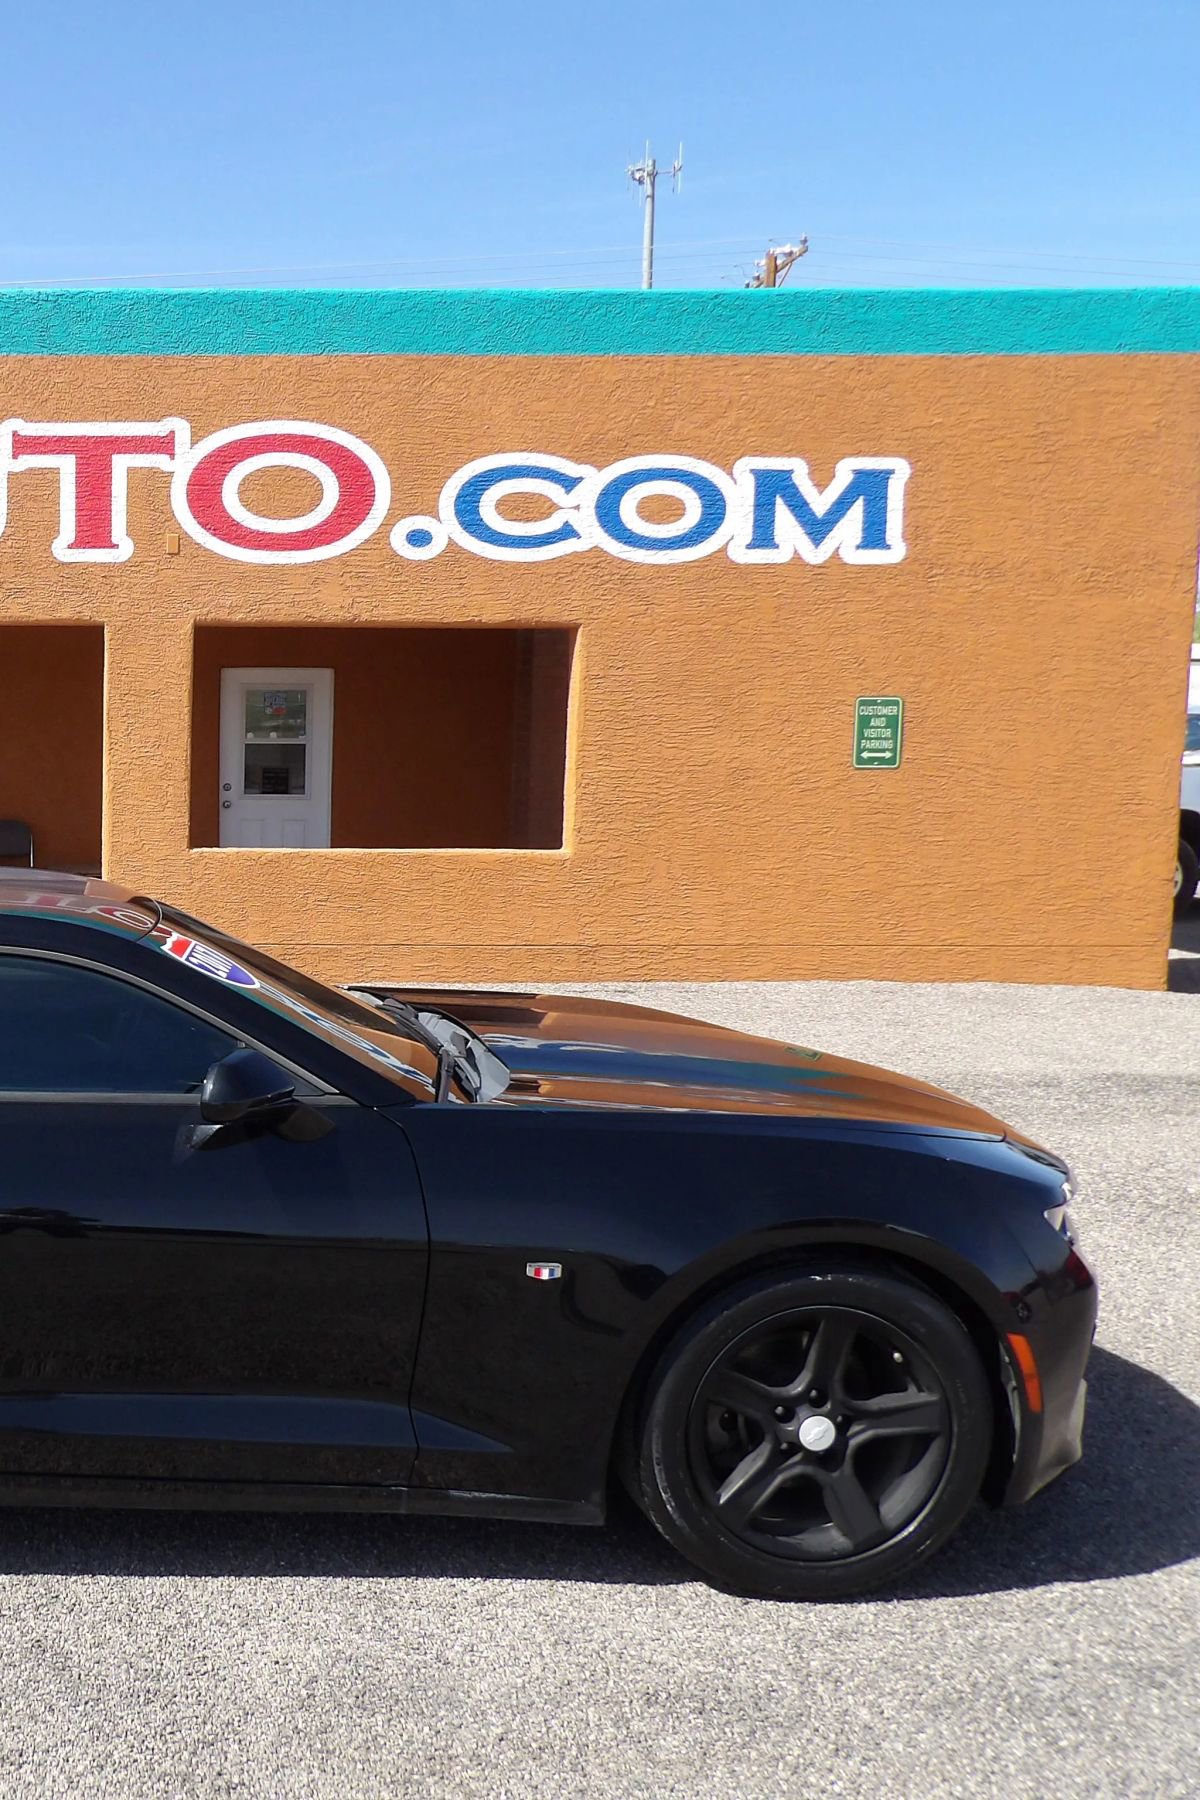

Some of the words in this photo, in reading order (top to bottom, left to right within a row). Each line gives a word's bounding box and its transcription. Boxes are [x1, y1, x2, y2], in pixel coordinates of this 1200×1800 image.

[859, 706, 897, 715] CUSTOMER
[870, 717, 886, 726] AND
[863, 728, 891, 737] VISITOR
[860, 740, 893, 749] PARKING
